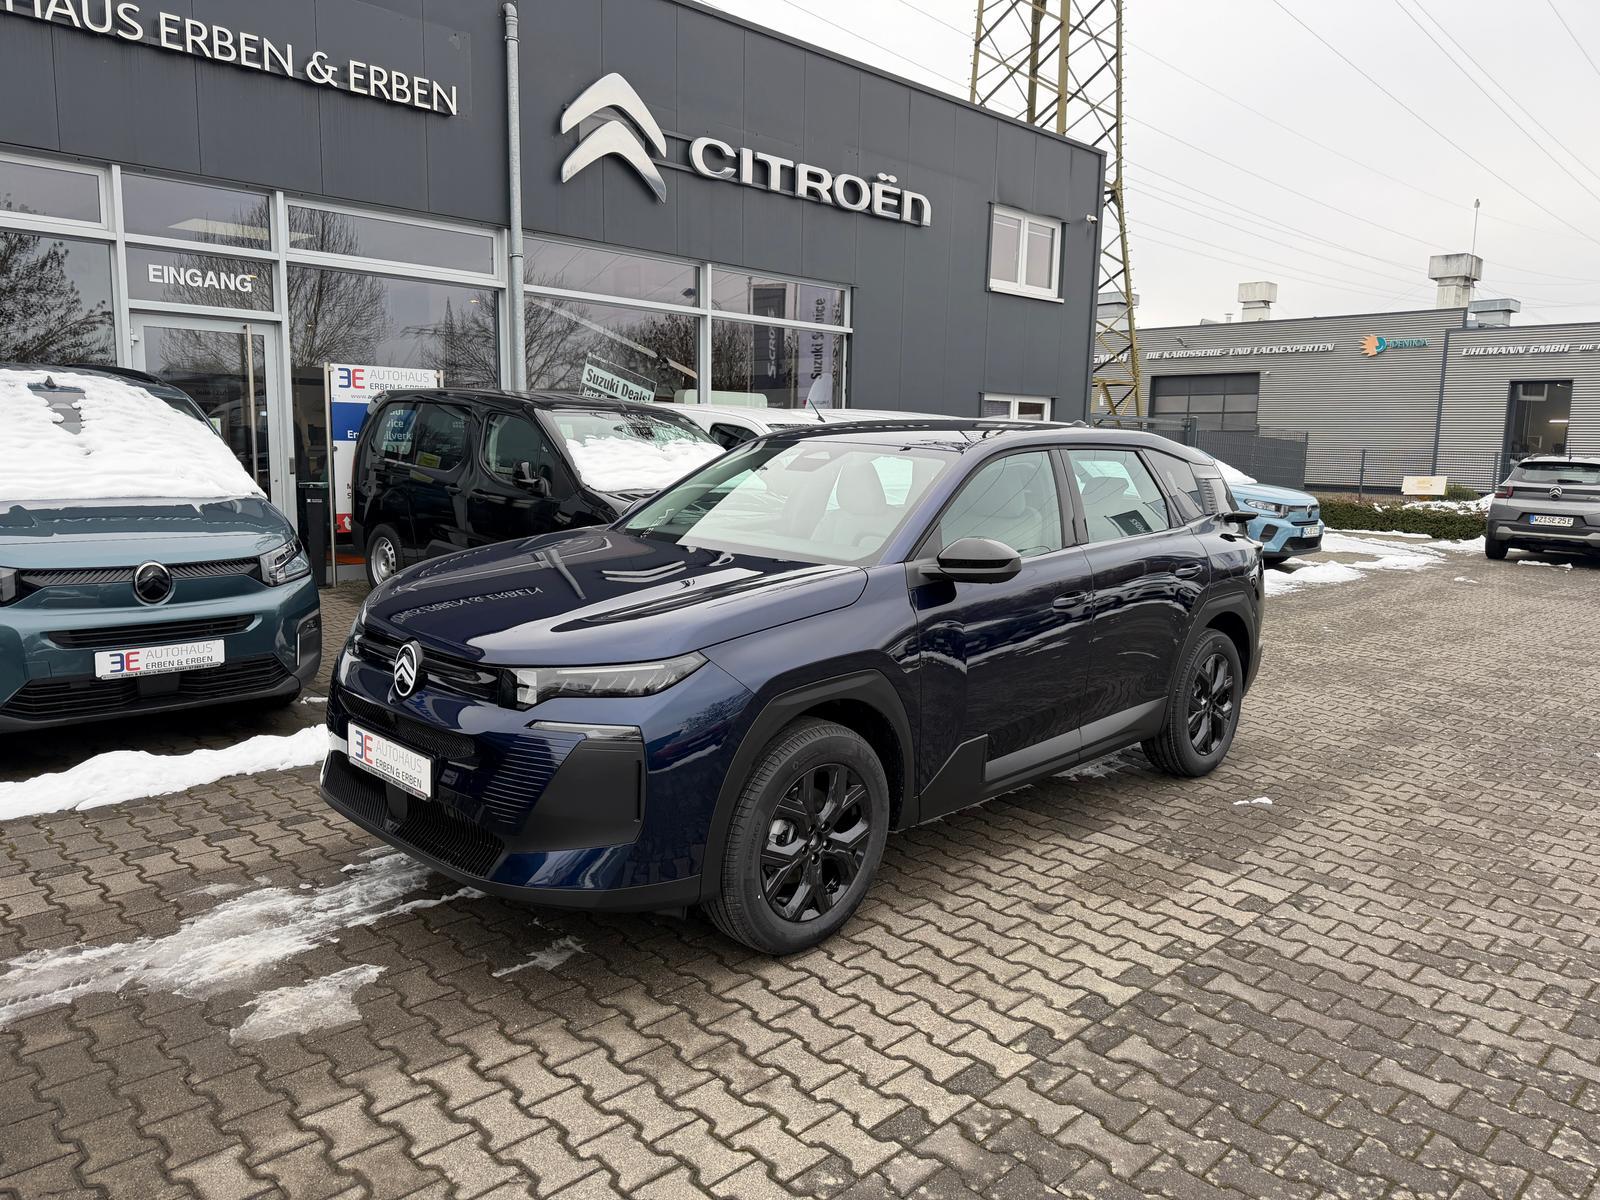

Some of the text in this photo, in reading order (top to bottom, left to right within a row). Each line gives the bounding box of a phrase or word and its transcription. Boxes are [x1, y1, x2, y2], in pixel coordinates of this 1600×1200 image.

[158, 11, 294, 77] ERBEN
[306, 52, 338, 87] &
[349, 60, 457, 116] ERBEN
[147, 263, 254, 293] EINGANG
[1146, 351, 1162, 360] DIE
[1462, 346, 1526, 356] UHLMANN
[1529, 344, 1570, 353] GMBH
[369, 369, 430, 383] AUTOHAUS
[586, 368, 620, 394] Suzuki
[145, 643, 213, 660] AUTOHAUS
[145, 660, 175, 670] ERBEN
[185, 655, 213, 665] ERBEN
[375, 740, 422, 774] AUTOHAUS
[375, 758, 395, 776] ERBEN
[395, 768, 401, 778] &
[401, 771, 422, 789] ERBEN
